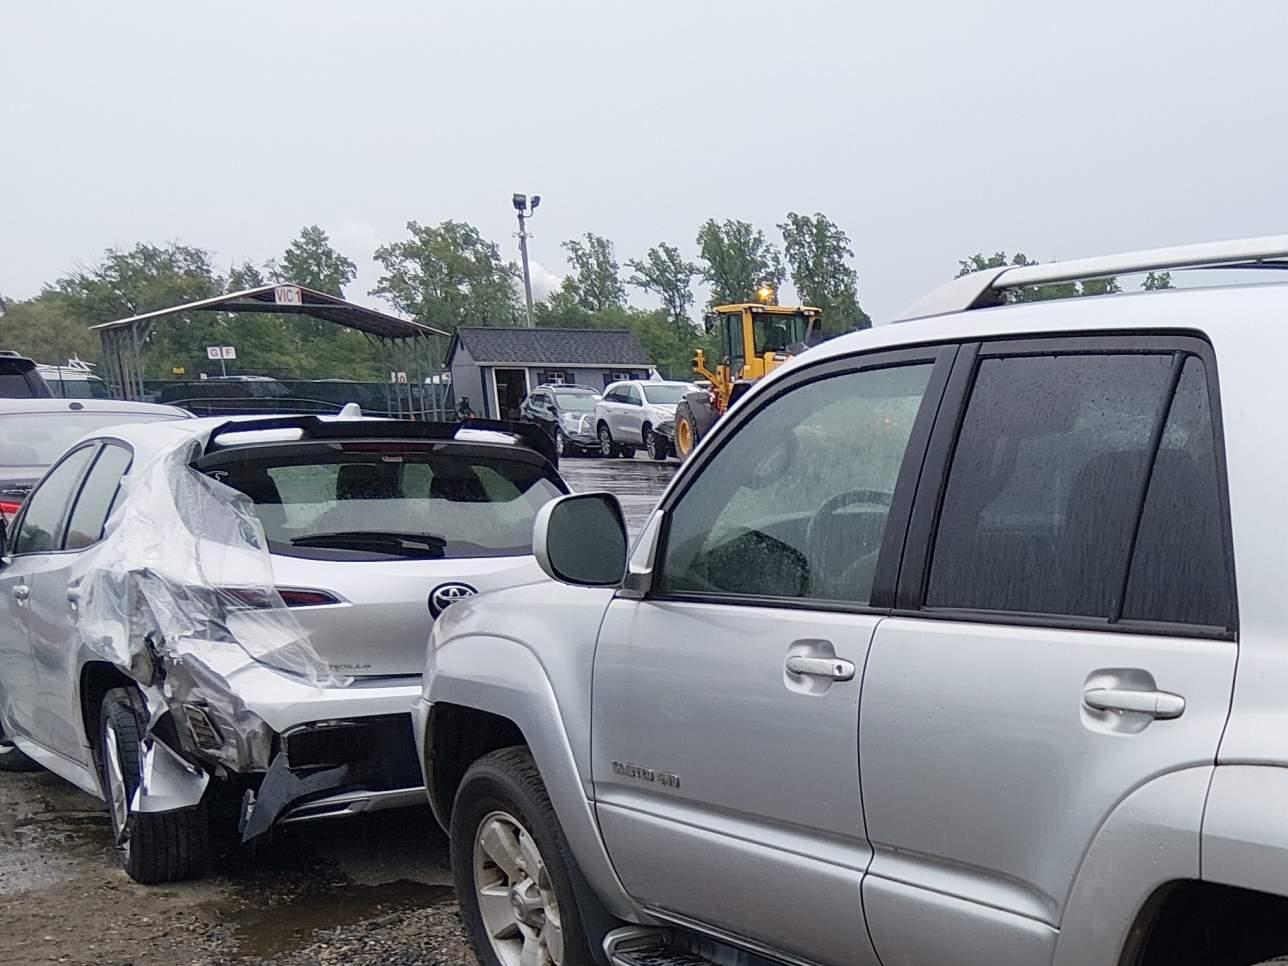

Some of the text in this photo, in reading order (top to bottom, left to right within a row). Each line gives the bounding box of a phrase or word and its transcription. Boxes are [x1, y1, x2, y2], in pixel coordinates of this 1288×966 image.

[276, 288, 301, 303] VIC 1
[210, 348, 219, 357] G
